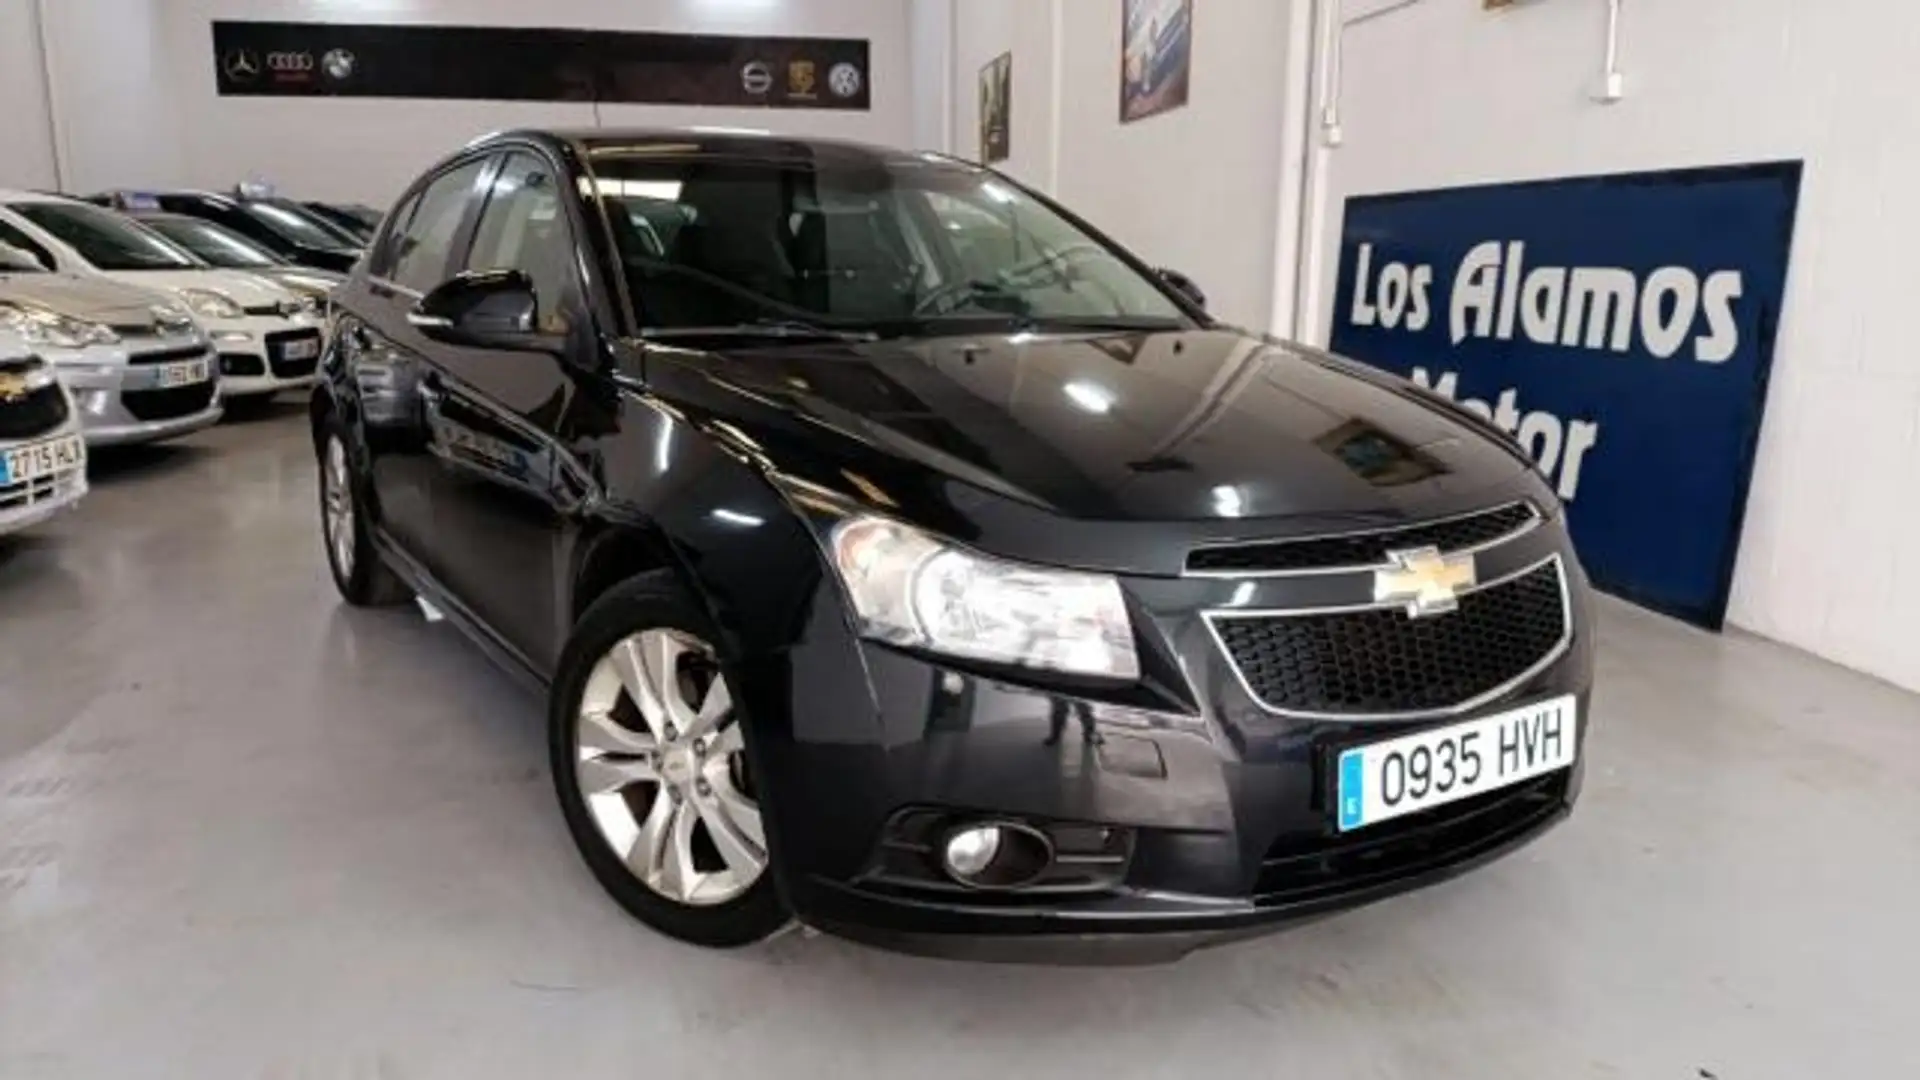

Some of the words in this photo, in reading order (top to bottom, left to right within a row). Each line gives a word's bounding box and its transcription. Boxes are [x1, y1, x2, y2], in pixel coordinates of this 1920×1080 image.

[1351, 243, 1432, 331] Los
[1412, 366, 1597, 499] tor
[1381, 731, 1481, 806] 0935
[1499, 707, 1562, 776] HVH
